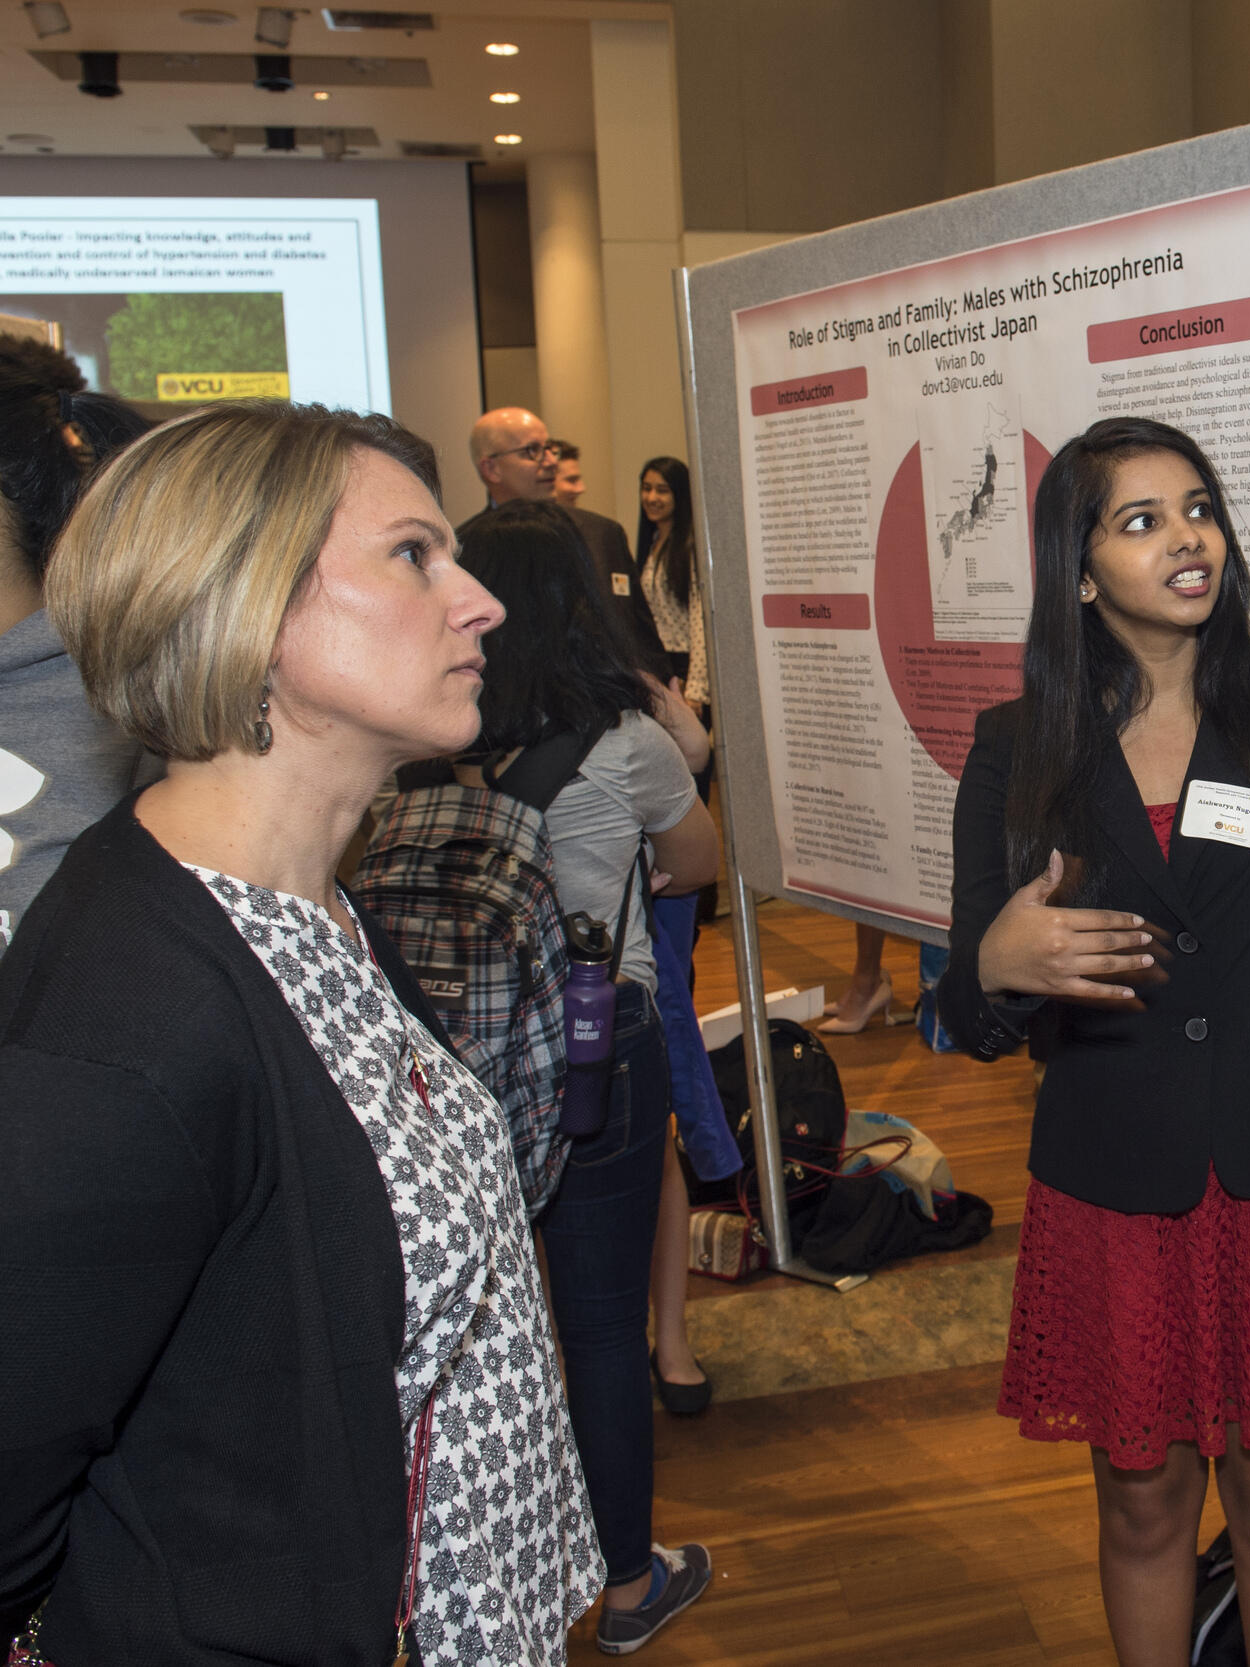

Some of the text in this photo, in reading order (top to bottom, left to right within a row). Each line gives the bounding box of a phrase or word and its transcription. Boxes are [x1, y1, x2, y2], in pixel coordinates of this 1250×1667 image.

[788, 249, 1184, 350] Role of Stigma and Family: Males with Schizophrenia
[888, 313, 1038, 358] in Collectivist Japan
[1139, 315, 1224, 346] Conclusion
[936, 351, 985, 372] Vivian Do
[1102, 371, 1125, 384] Stigma
[1127, 369, 1142, 379] from
[1144, 364, 1177, 377] traditional
[1179, 359, 1217, 373] collectivist
[1219, 355, 1240, 366] ideals
[181, 380, 223, 394] VCU
[776, 381, 834, 406] Introduction
[922, 370, 1003, 398] dovt3@vcu.edu
[800, 603, 831, 619] Results
[1223, 823, 1244, 834] VCU
